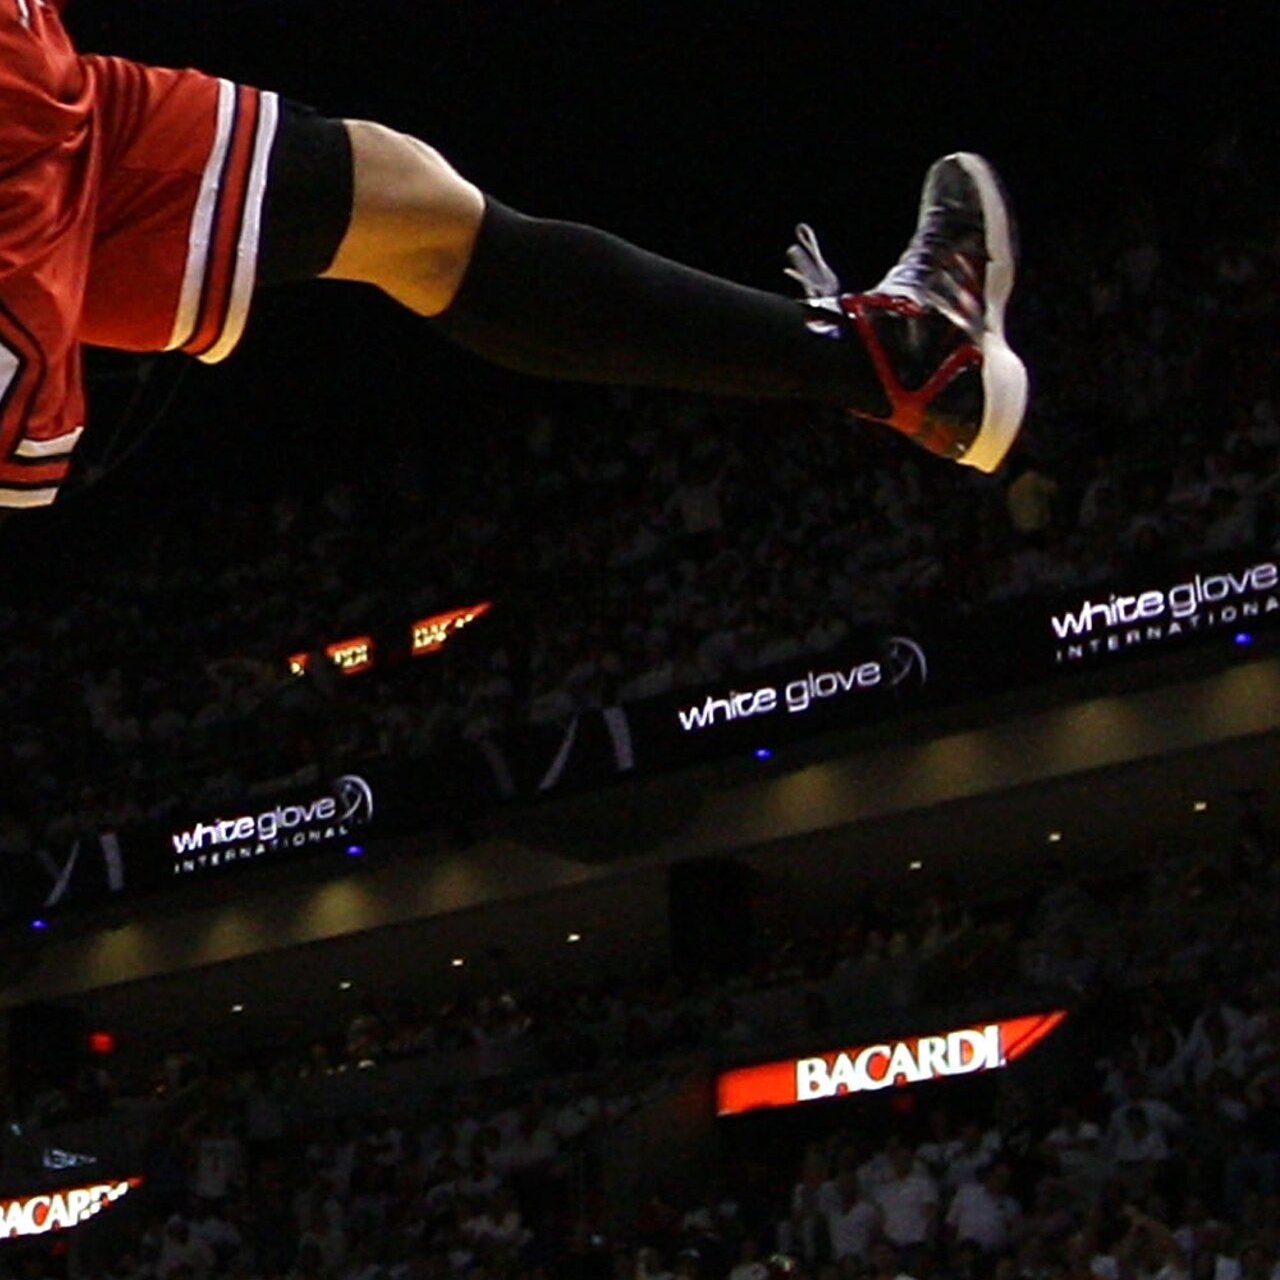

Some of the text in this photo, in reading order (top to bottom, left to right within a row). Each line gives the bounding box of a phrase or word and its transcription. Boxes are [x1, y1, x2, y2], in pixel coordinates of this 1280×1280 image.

[1051, 562, 1279, 639] white glove
[677, 661, 882, 731] white glove
[172, 797, 336, 854] white glove
[796, 1024, 1003, 1102] BACARDI
